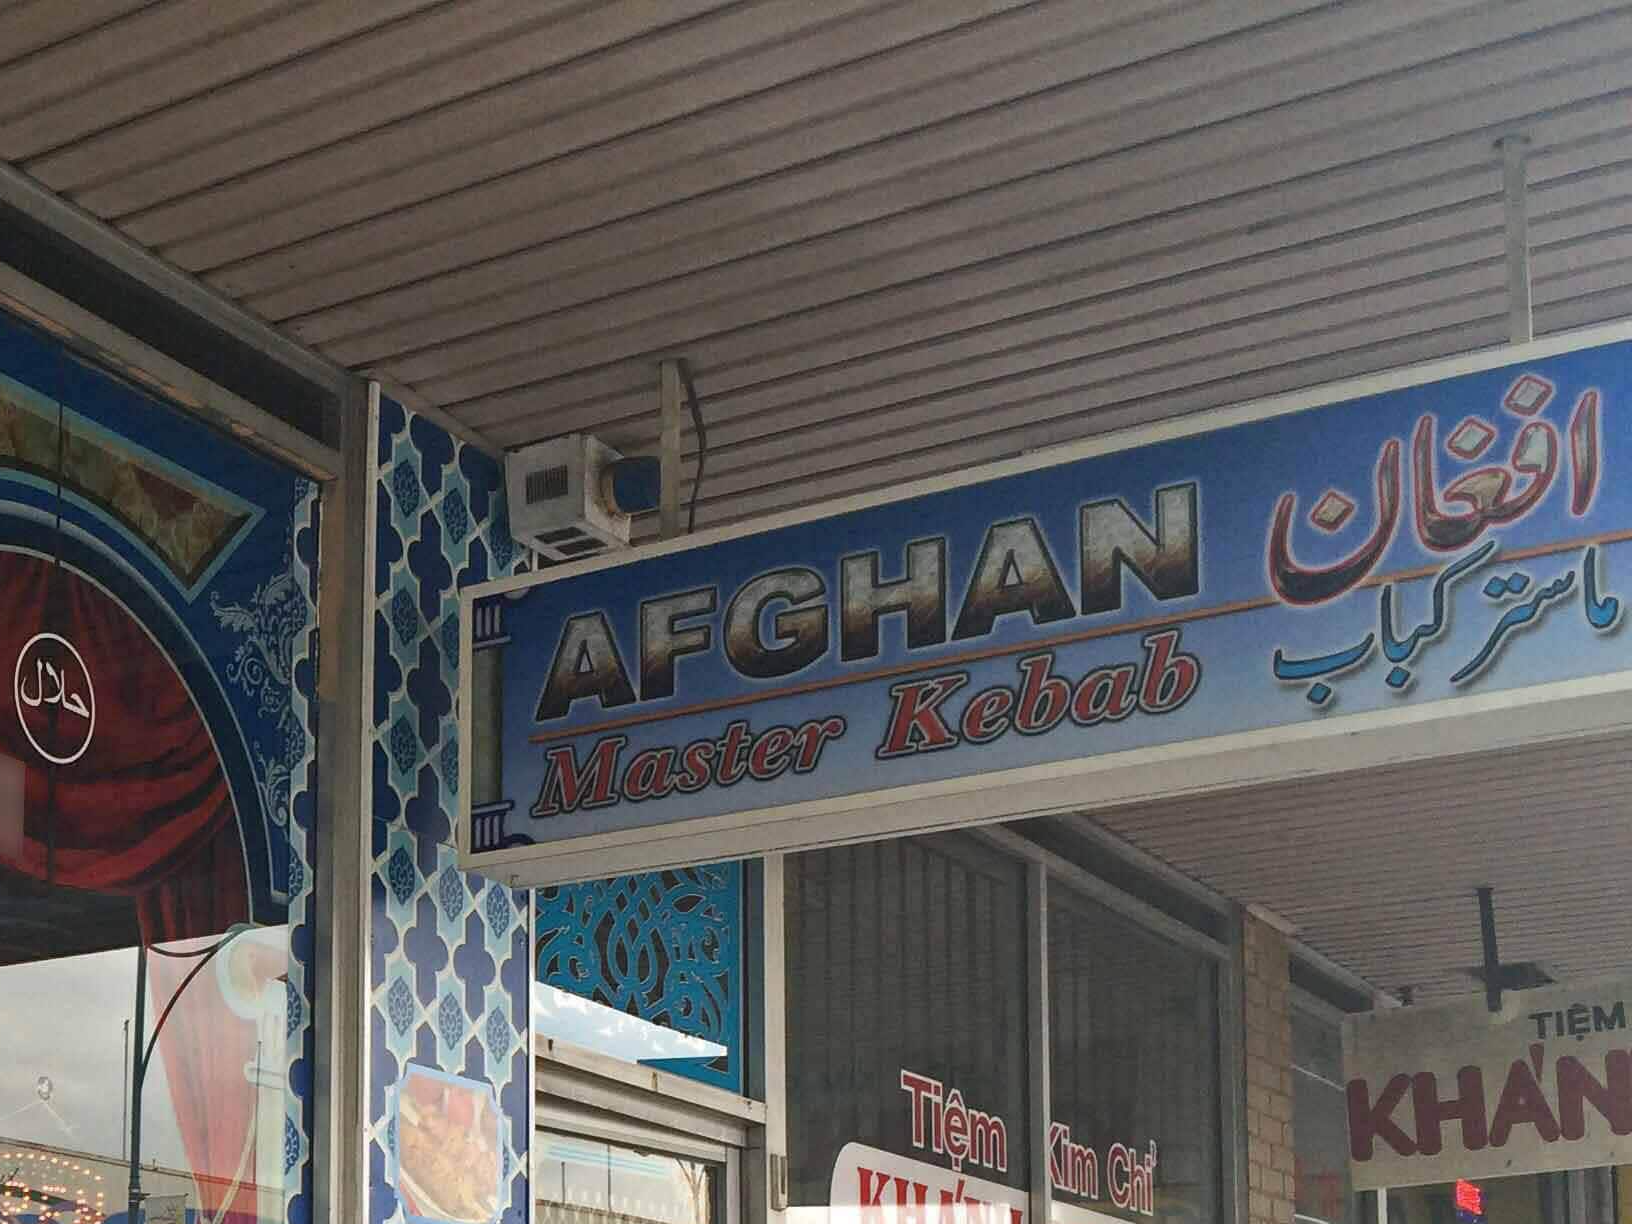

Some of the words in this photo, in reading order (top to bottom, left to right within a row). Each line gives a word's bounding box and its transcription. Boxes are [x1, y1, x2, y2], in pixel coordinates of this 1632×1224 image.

[1268, 376, 1598, 606] افغان
[536, 481, 1199, 721] AFGHAN
[21, 658, 89, 718] حلال
[531, 712, 846, 817] Master
[878, 627, 1202, 760] Kebab
[1528, 1001, 1626, 1041] TIỆM
[901, 1069, 1007, 1173] Tiệm
[1048, 1121, 1098, 1199] Kim
[1107, 1139, 1158, 1216] Chỉ
[1347, 1043, 1632, 1162] KHÁN
